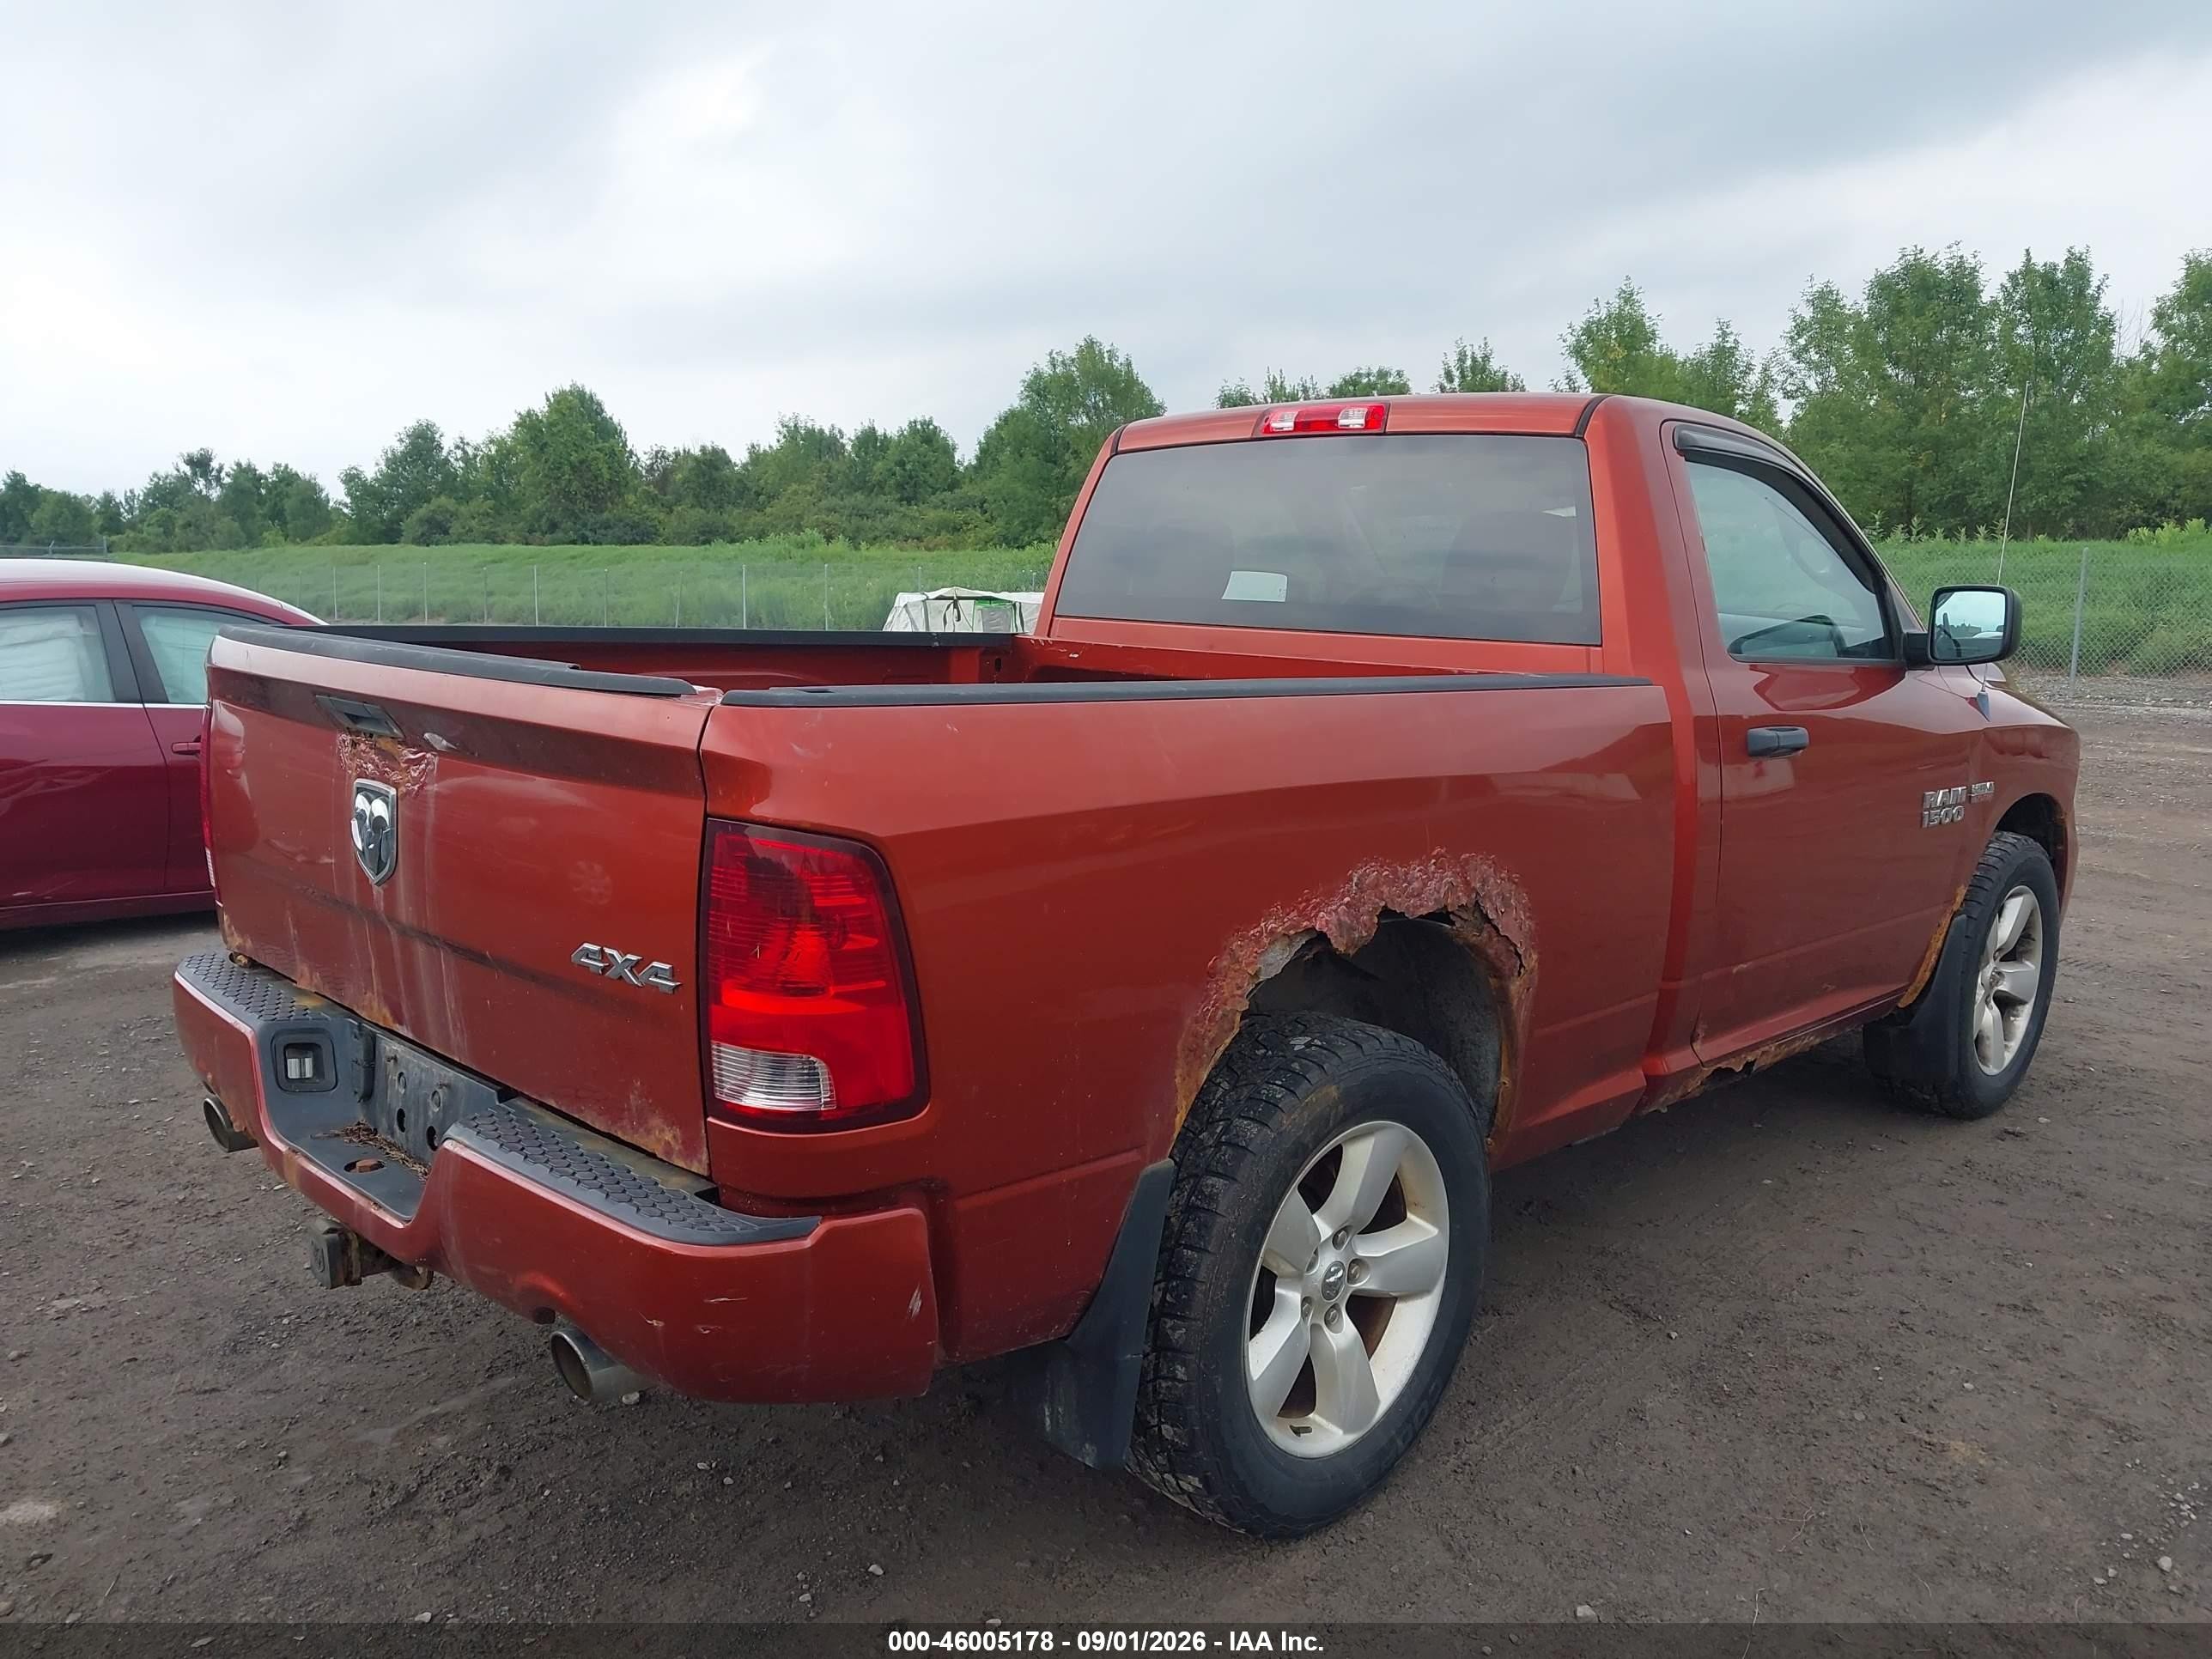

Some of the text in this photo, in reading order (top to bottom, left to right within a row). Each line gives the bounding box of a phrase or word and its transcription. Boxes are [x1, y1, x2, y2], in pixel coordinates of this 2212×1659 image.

[1923, 787, 1966, 807] RAM
[1922, 806, 1965, 828] 1500
[571, 943, 683, 994] 4X4
